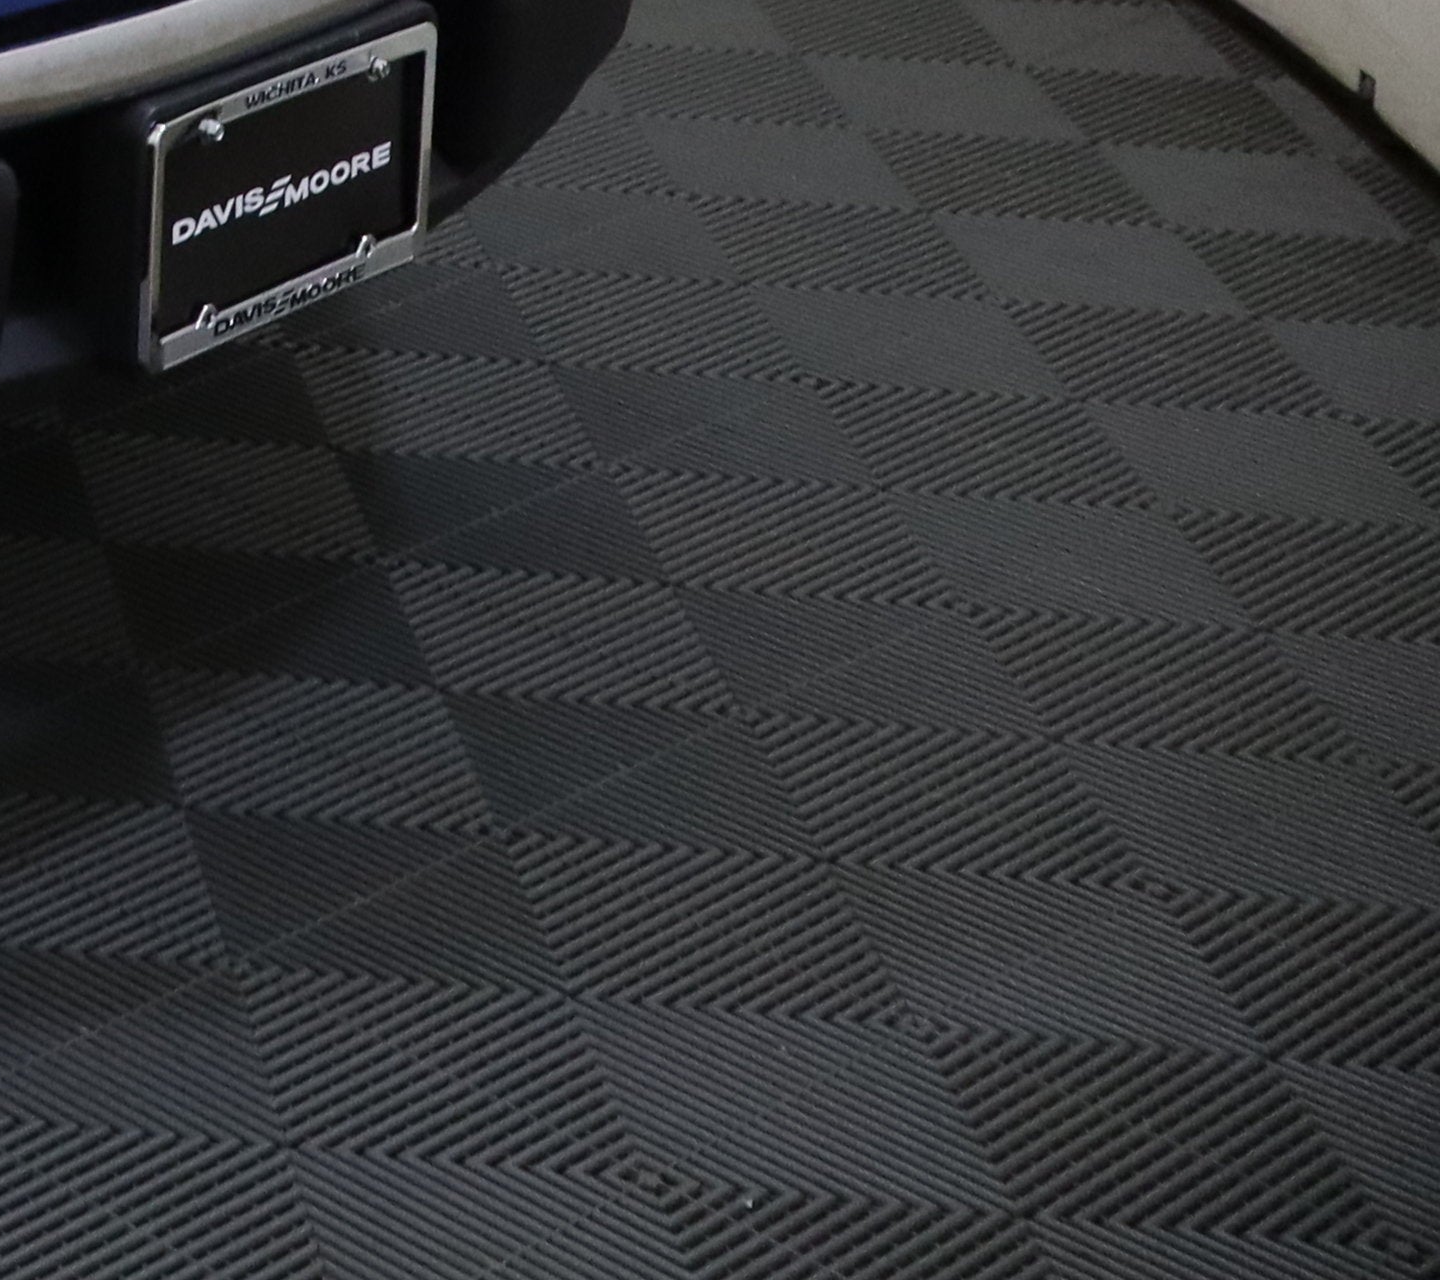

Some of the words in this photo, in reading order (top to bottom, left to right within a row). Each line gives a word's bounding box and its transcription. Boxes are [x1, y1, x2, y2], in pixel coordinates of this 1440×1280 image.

[325, 59, 347, 79] KS
[171, 186, 270, 246] DAVIS
[283, 140, 393, 209] MOORE
[213, 297, 277, 337] DAVIS
[289, 263, 367, 308] MOORE
